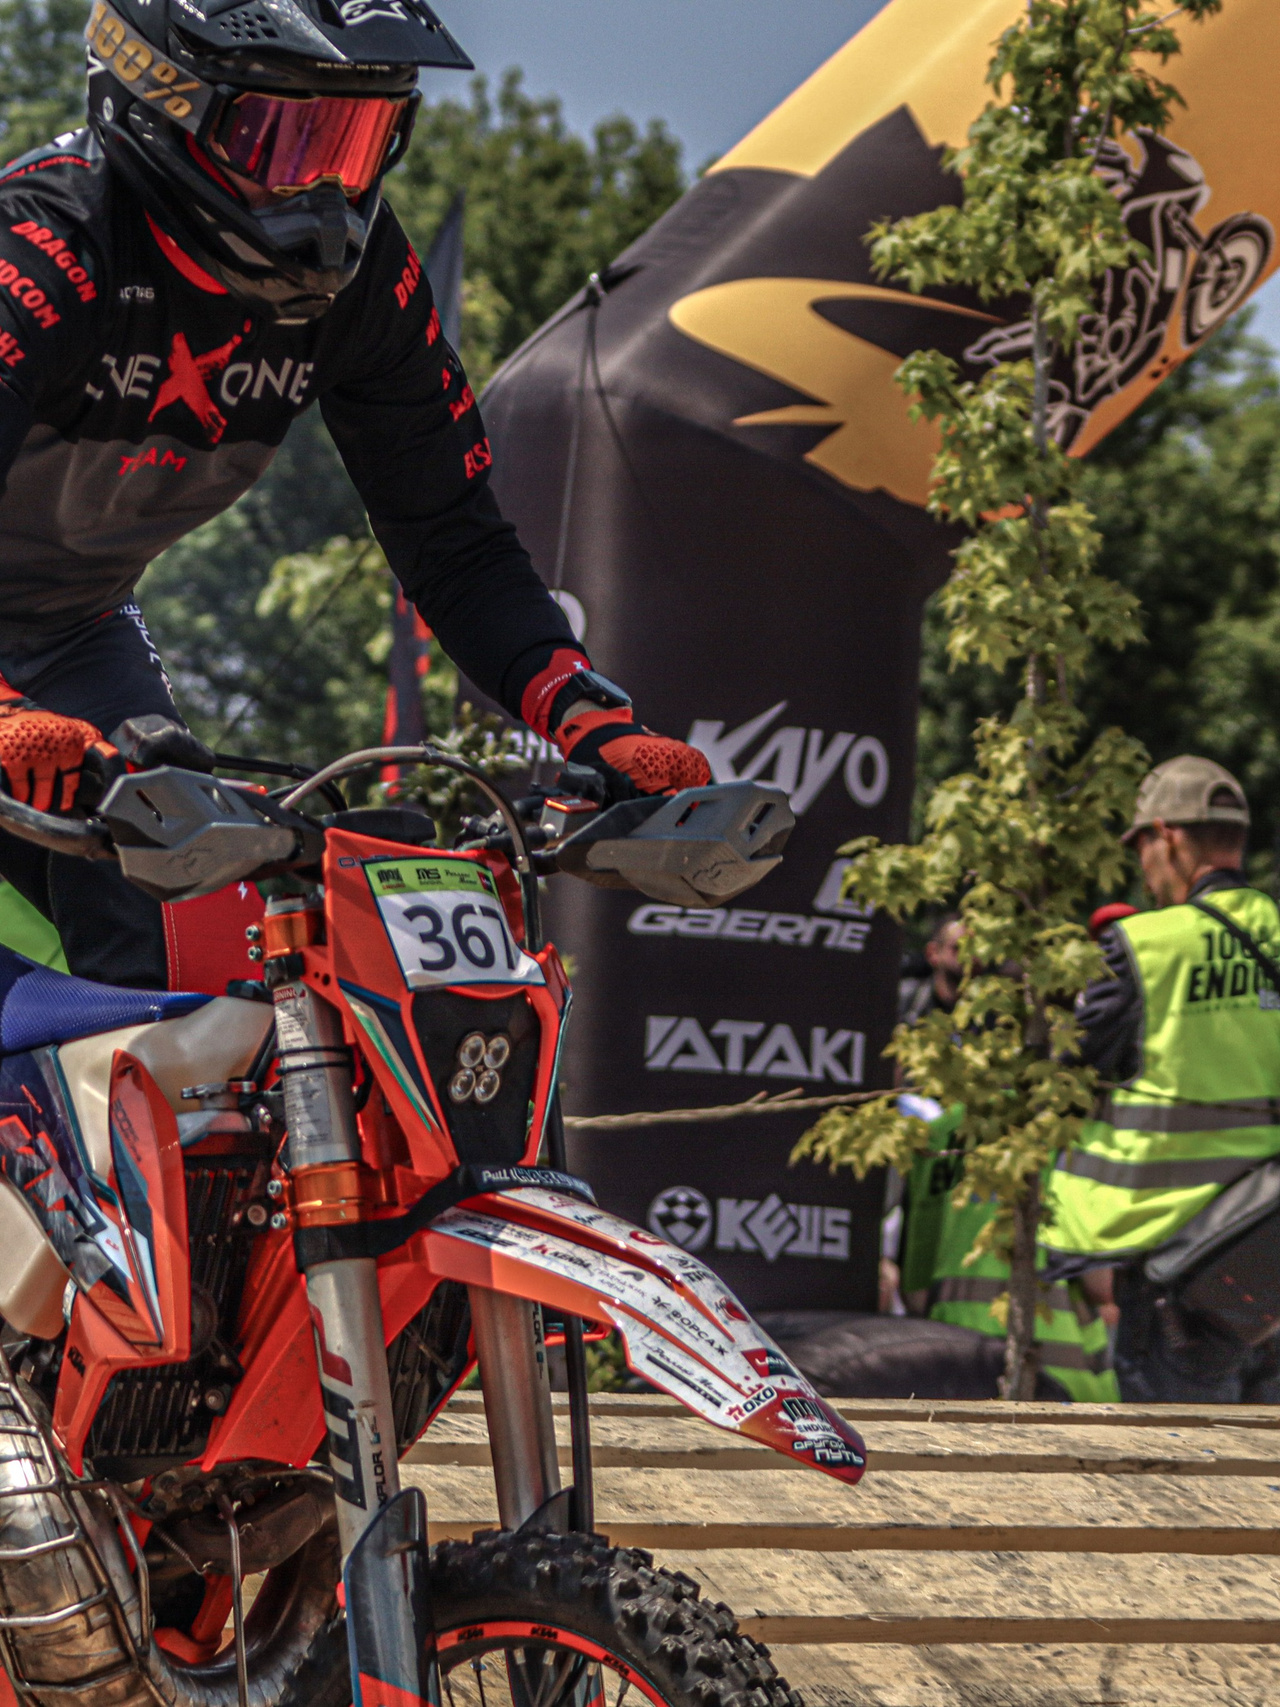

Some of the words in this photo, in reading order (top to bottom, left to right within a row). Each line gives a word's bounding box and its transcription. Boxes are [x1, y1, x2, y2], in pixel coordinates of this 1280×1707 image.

[87, 3, 203, 120] 100%
[10, 220, 98, 303] DRAGON
[393, 241, 422, 310] DRA
[402, 903, 516, 971] 367
[670, 1309, 729, 1357] ФОРСАЖ
[66, 1346, 84, 1377] KTM
[793, 1437, 847, 1453] ДРУГОЙ
[797, 1421, 837, 1436] ENDURO
[814, 1444, 865, 1467] ПУТЬ
[530, 1626, 558, 1640] KTM
